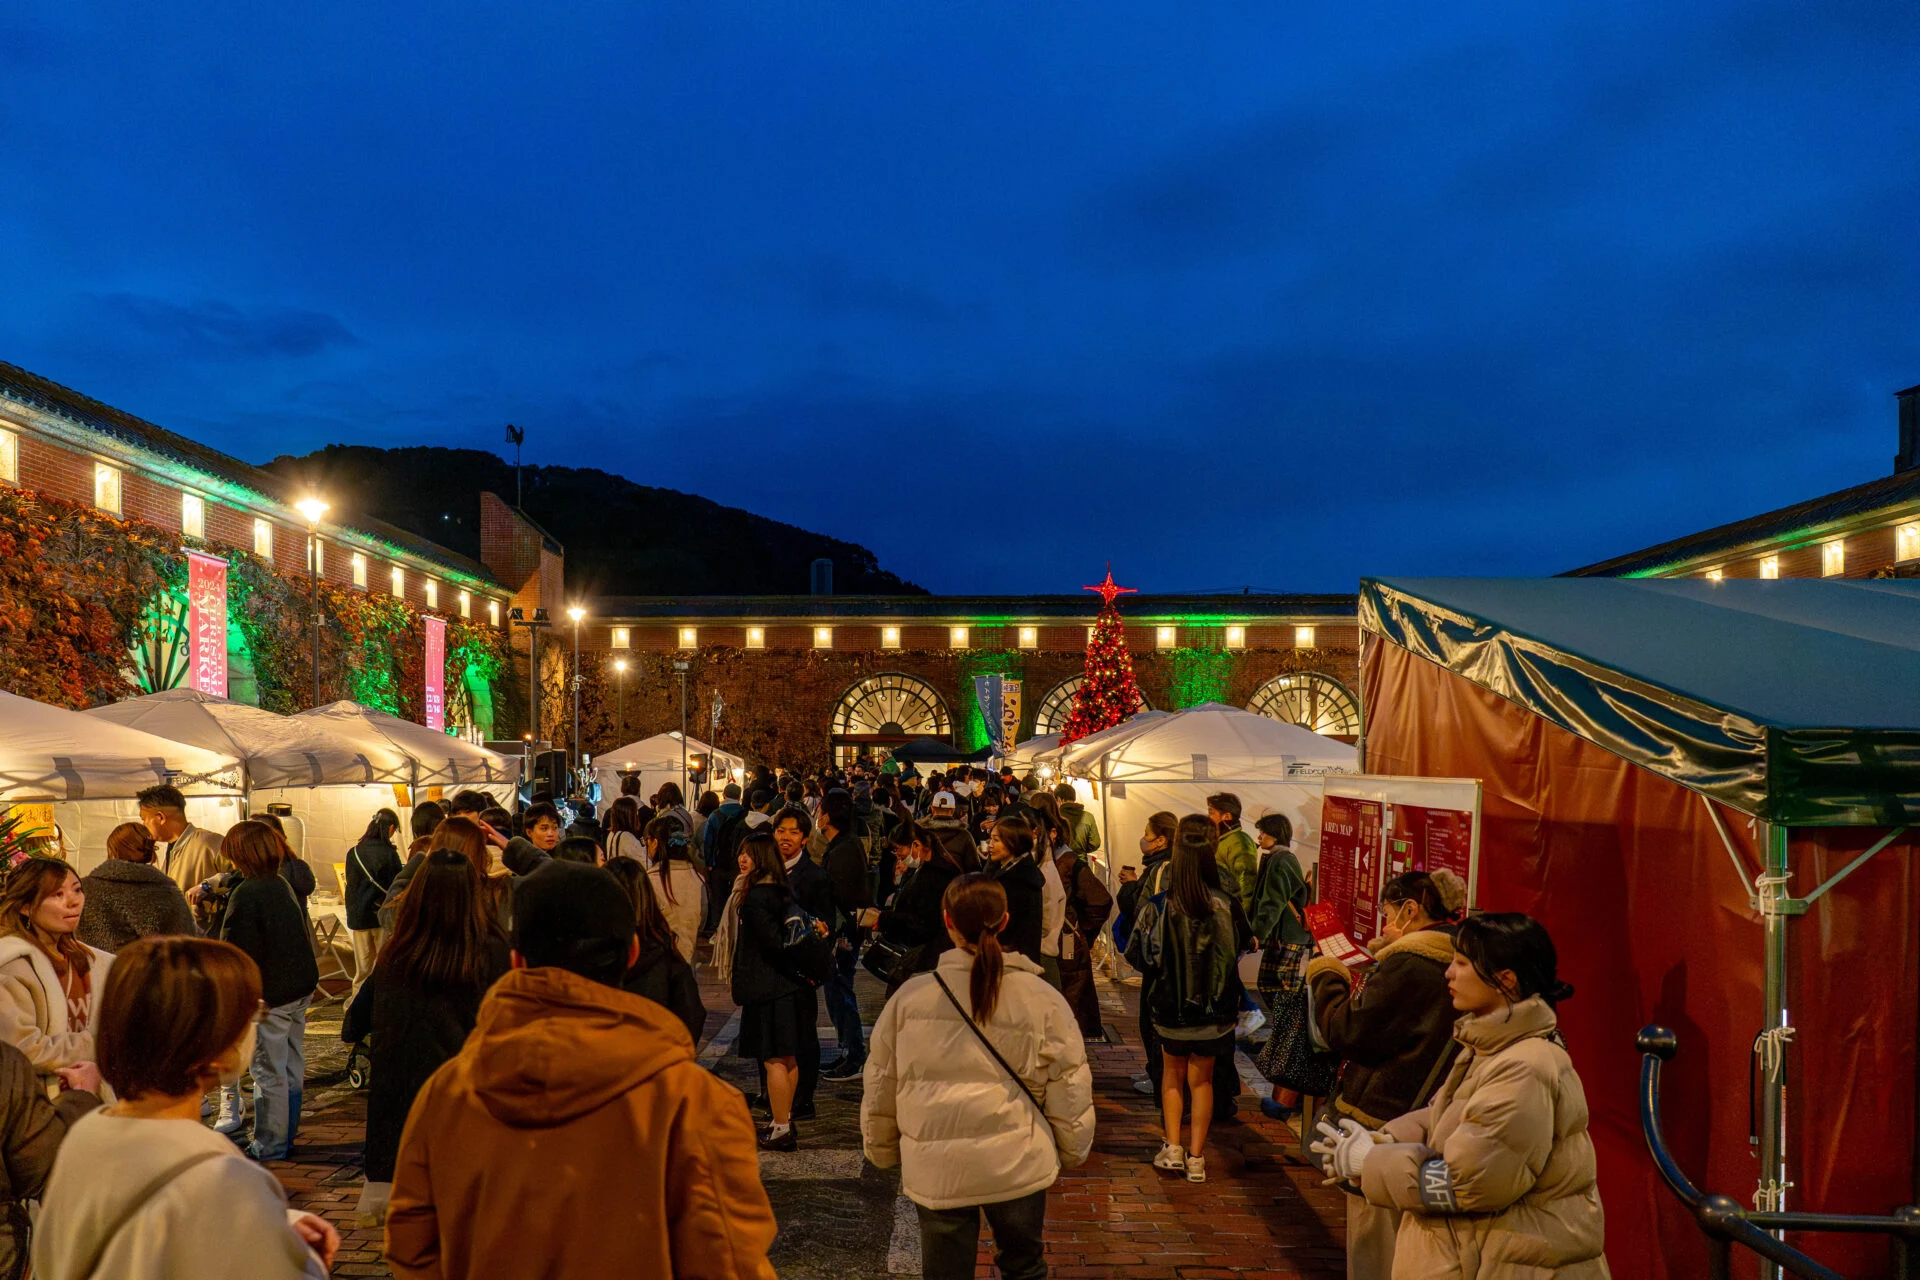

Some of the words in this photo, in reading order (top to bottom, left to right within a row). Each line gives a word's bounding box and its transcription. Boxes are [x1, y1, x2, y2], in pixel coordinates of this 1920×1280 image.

[198, 577, 221, 593] 2024
[1324, 821, 1339, 834] AREA
[1340, 824, 1353, 837] MAP
[1425, 1160, 1456, 1213] STAFF
